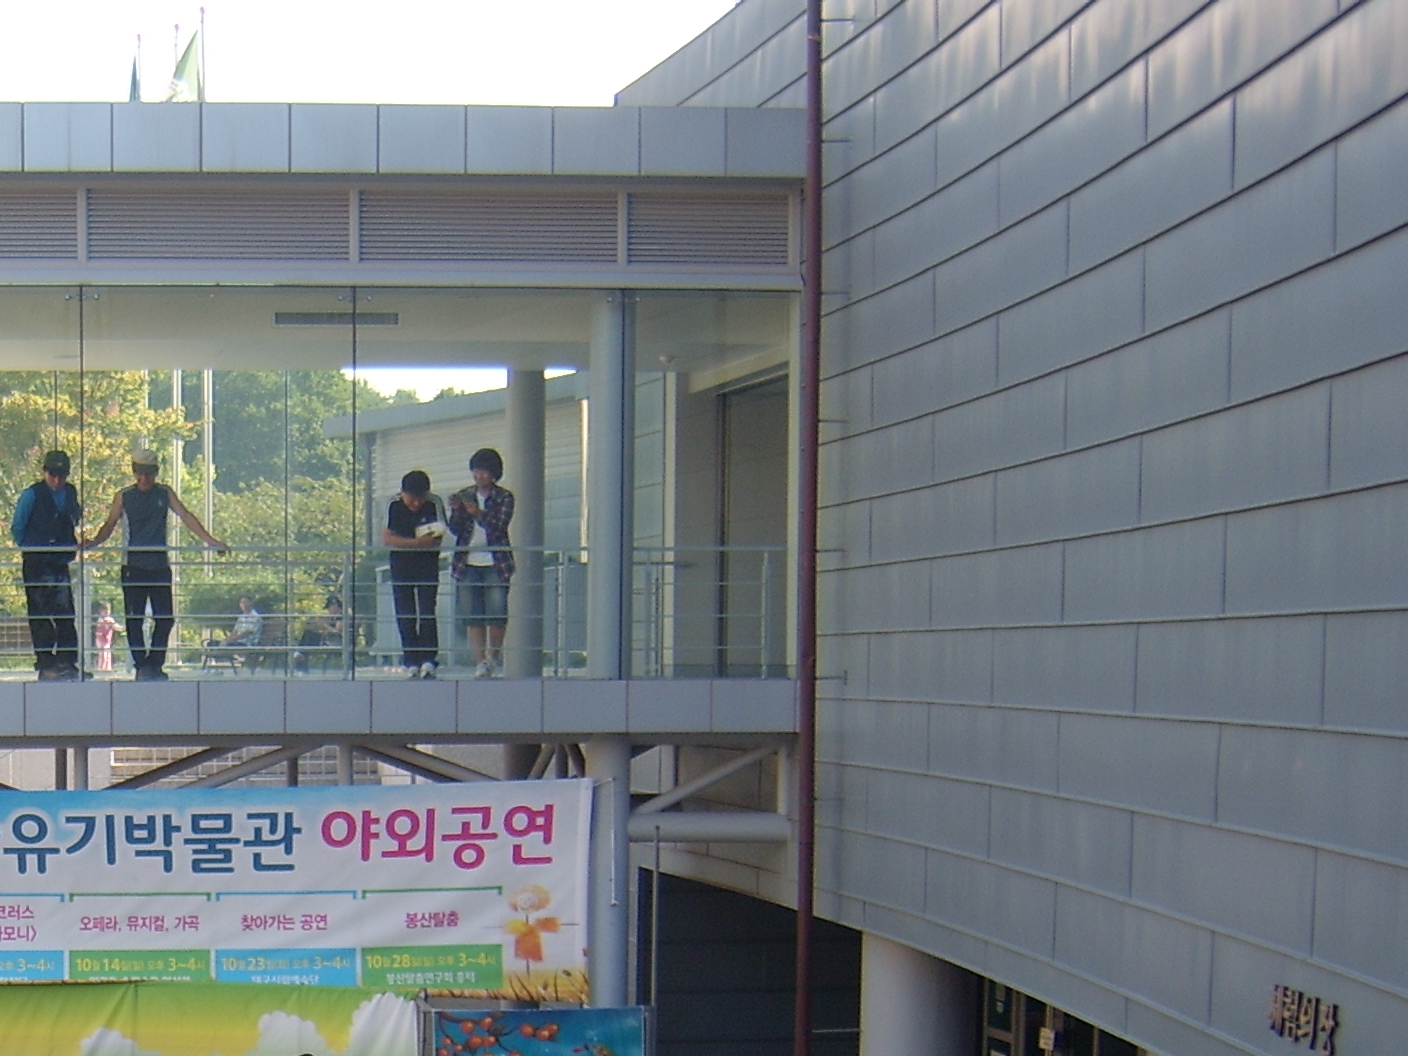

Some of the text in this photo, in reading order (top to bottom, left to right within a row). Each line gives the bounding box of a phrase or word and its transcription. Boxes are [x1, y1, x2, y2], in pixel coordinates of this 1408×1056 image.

[320, 803, 556, 871] 야외공연
[79, 914, 201, 933] 오페라, 뮤지컬, 가곡
[241, 913, 329, 932] 찾아가는 공연
[404, 911, 460, 930] 봉산탈춤
